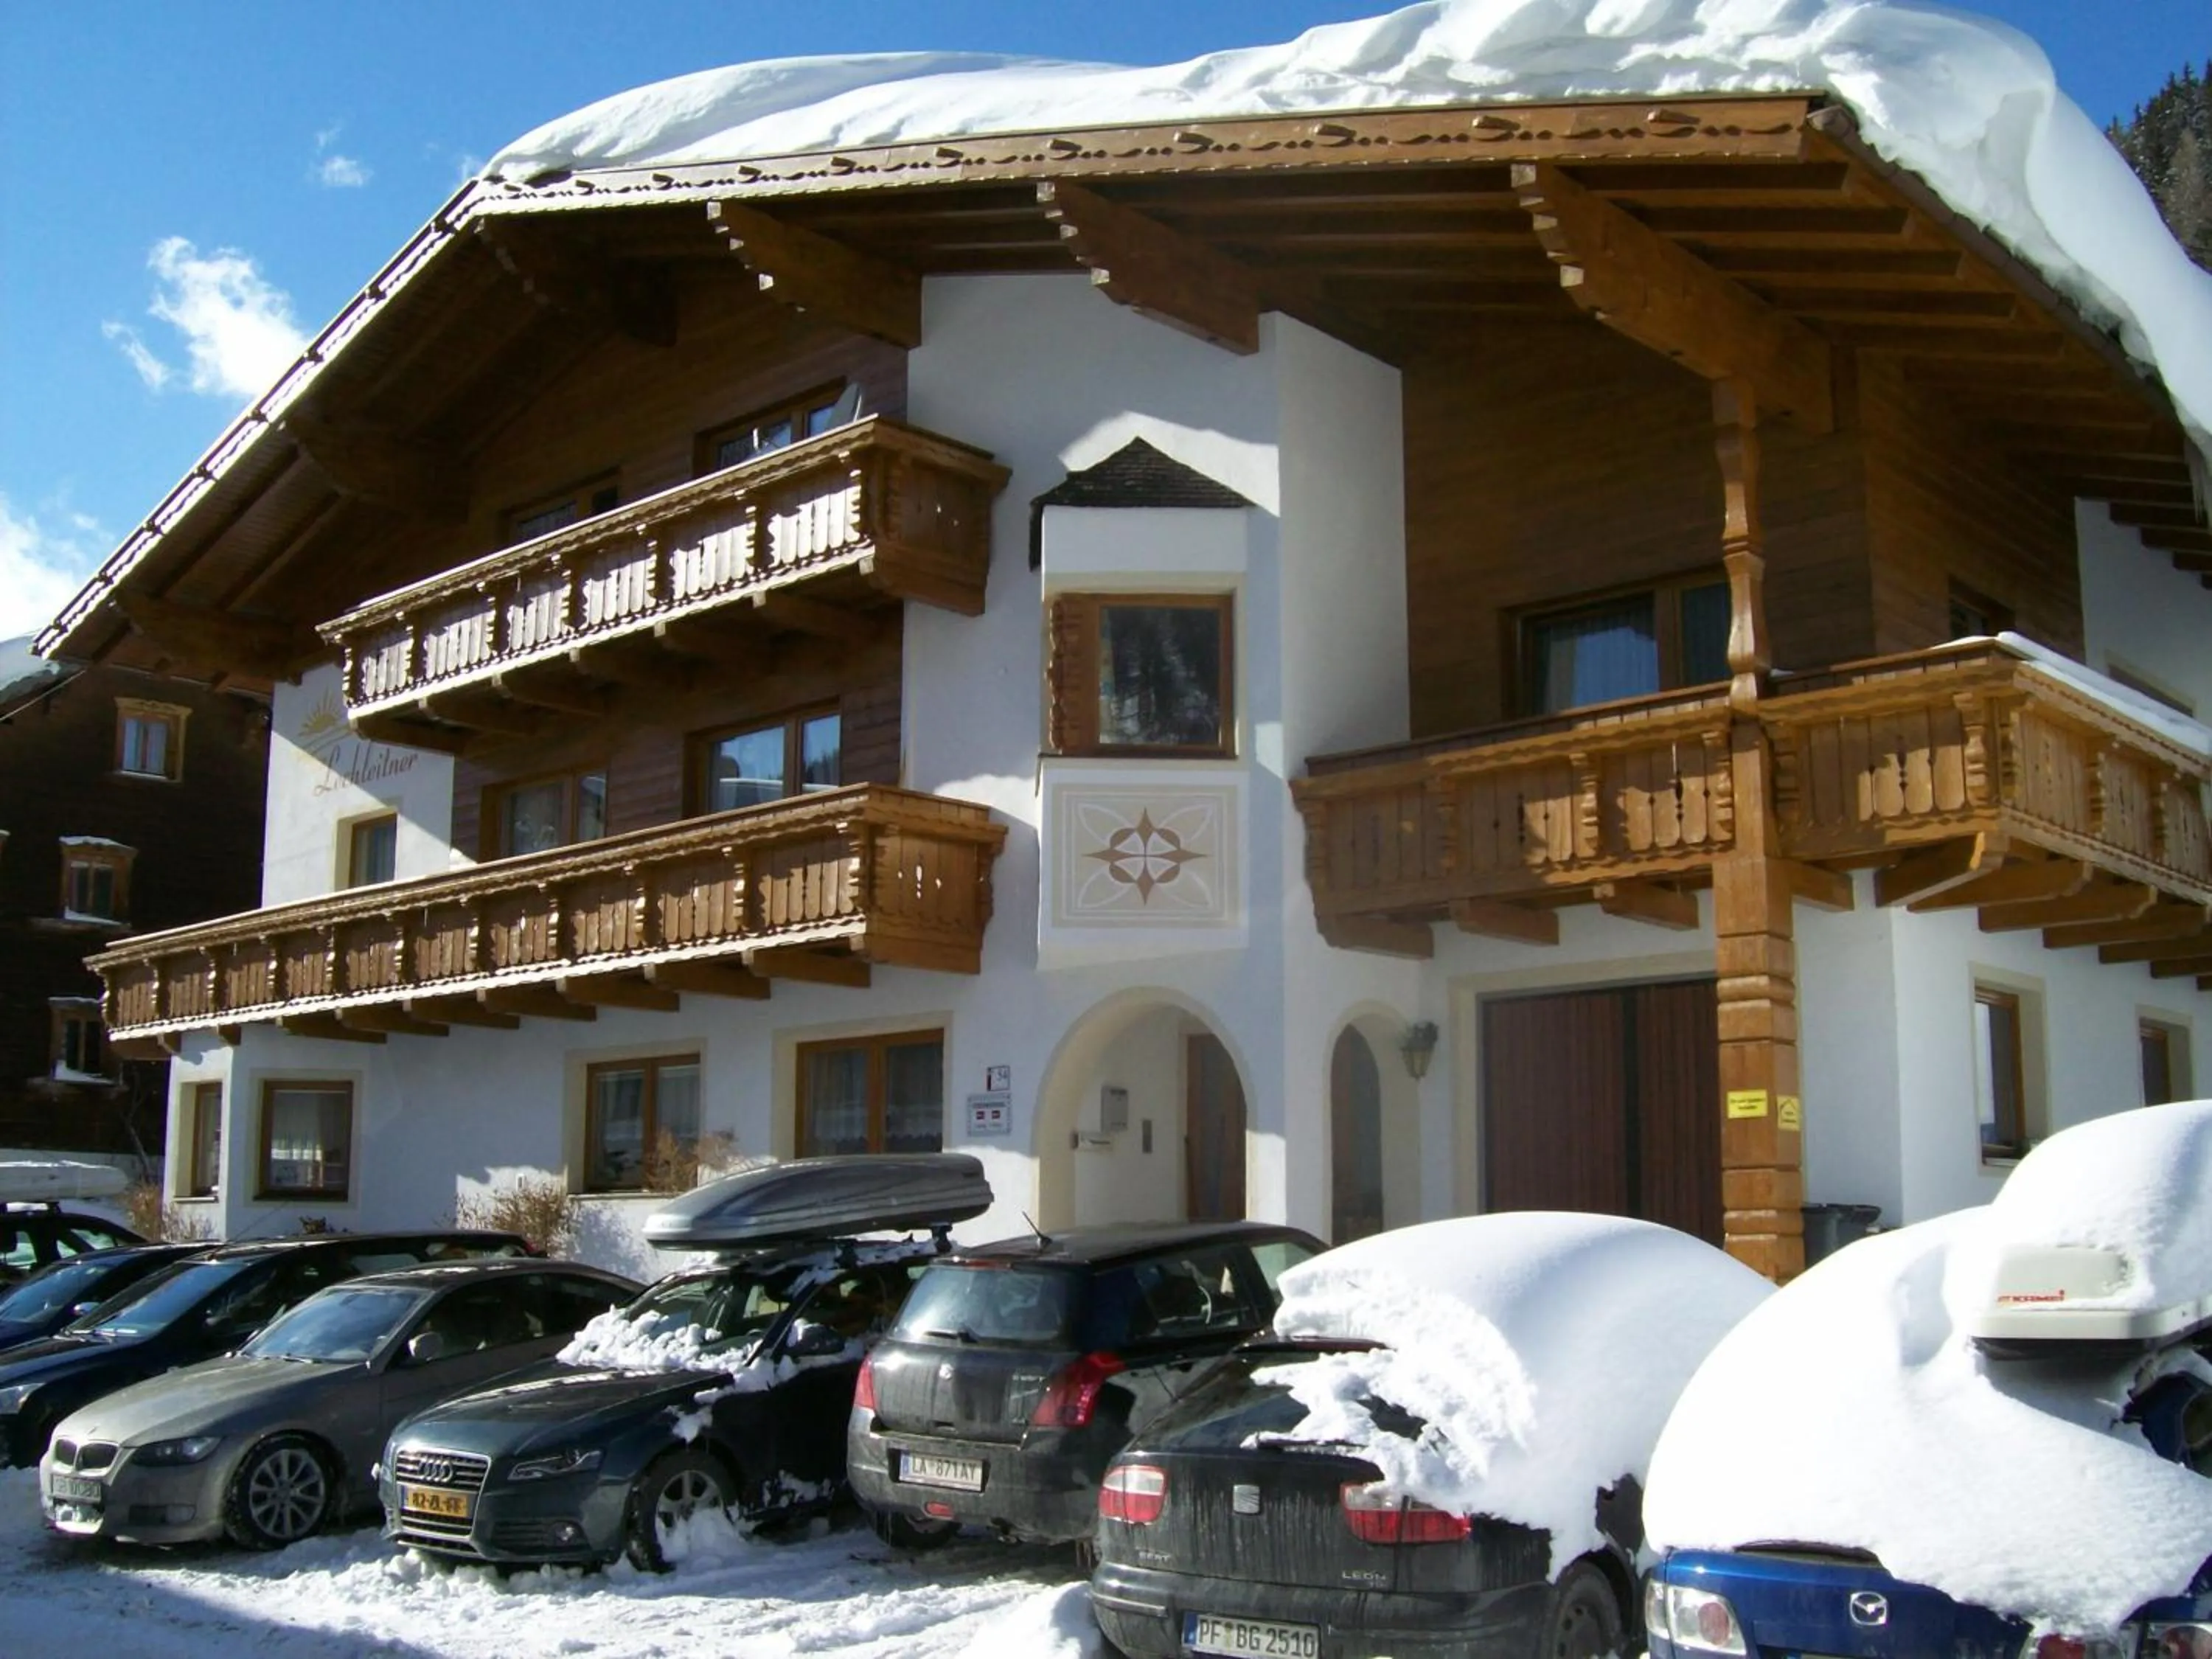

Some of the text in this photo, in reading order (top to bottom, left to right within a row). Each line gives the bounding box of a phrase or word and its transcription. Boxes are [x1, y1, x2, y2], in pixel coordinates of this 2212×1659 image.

[313, 742, 418, 796] Lechleitner
[913, 1455, 927, 1475] LA
[1199, 1619, 1316, 1658] PF BG 2510
